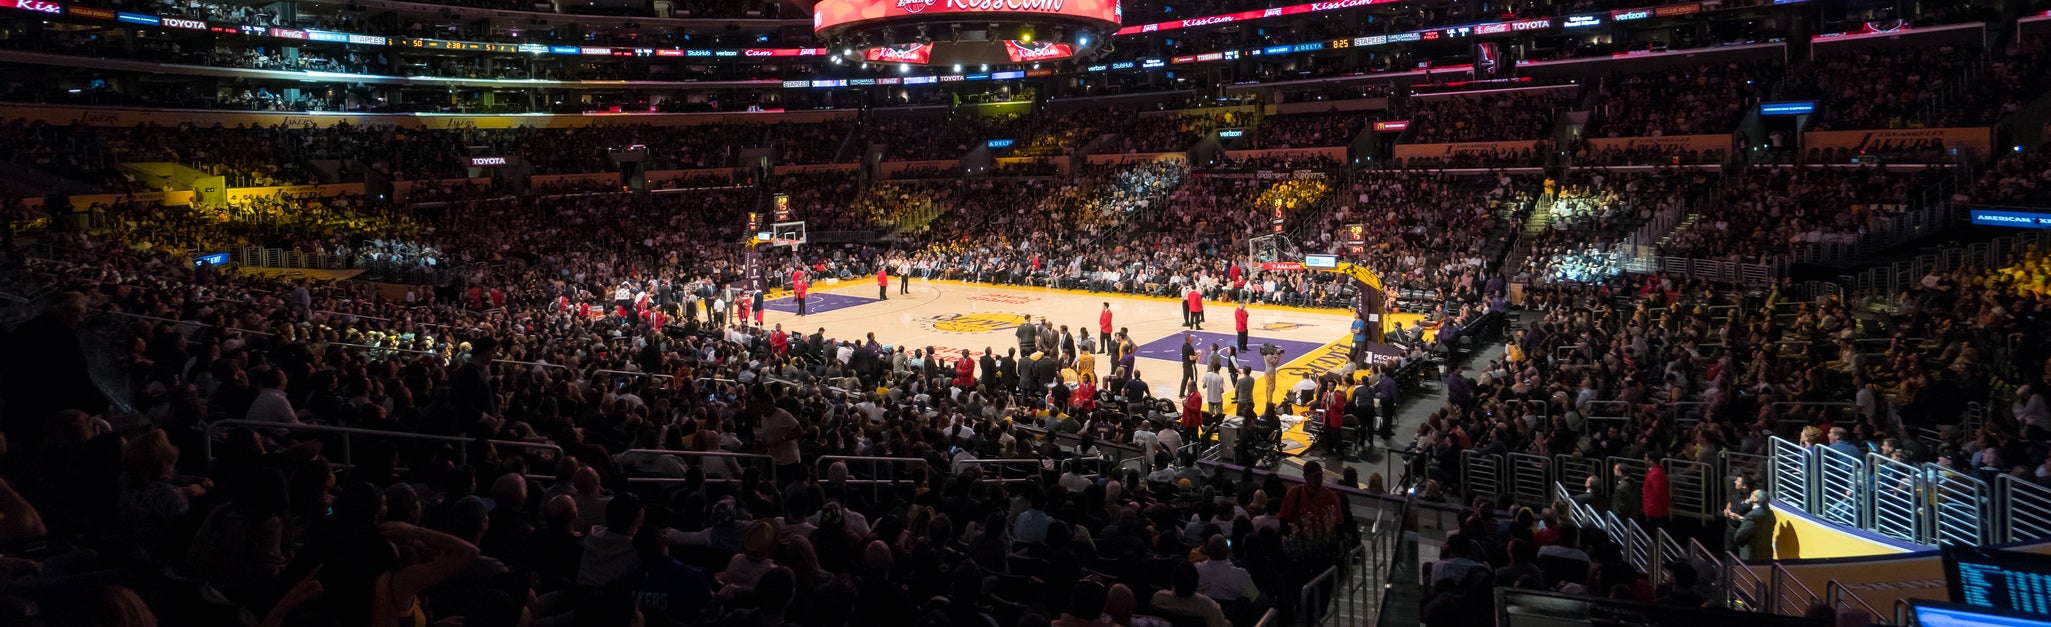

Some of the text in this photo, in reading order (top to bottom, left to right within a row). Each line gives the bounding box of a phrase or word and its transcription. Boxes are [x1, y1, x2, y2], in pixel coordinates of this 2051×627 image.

[1614, 12, 1646, 20] verizon
[162, 18, 206, 29] TOYOTA
[1182, 16, 1234, 27] KissCam
[1512, 20, 1550, 30] TOYOTA
[1484, 24, 1506, 34] Coca-Cola
[280, 30, 303, 38] Coca-Cola
[351, 35, 384, 44] STAPLES
[1333, 39, 1348, 48] 8:25
[1355, 36, 1385, 45] STAPLES
[1197, 53, 1222, 61] TOSHIBA
[282, 117, 315, 126] LAKERS
[472, 158, 506, 166] TOYOTA
